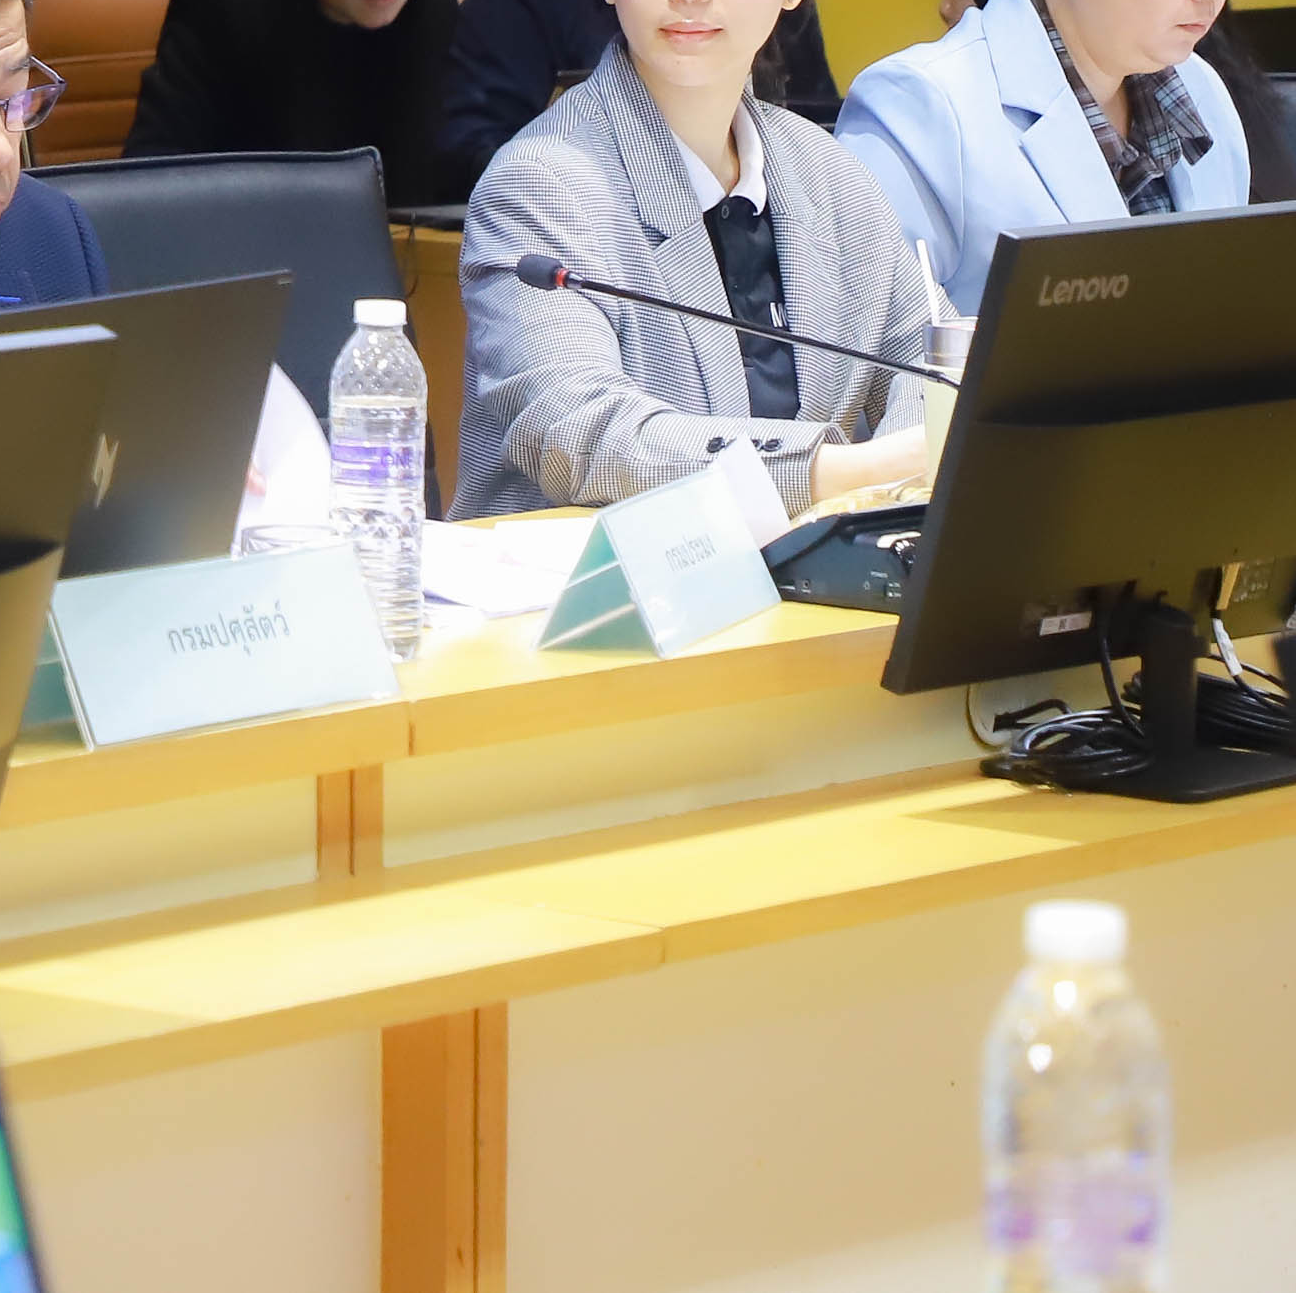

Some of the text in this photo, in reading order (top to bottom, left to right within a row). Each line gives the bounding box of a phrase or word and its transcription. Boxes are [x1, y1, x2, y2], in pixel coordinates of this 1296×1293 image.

[1038, 273, 1130, 307] Lenovo
[167, 599, 291, 657] กรมปศุสัตว์
